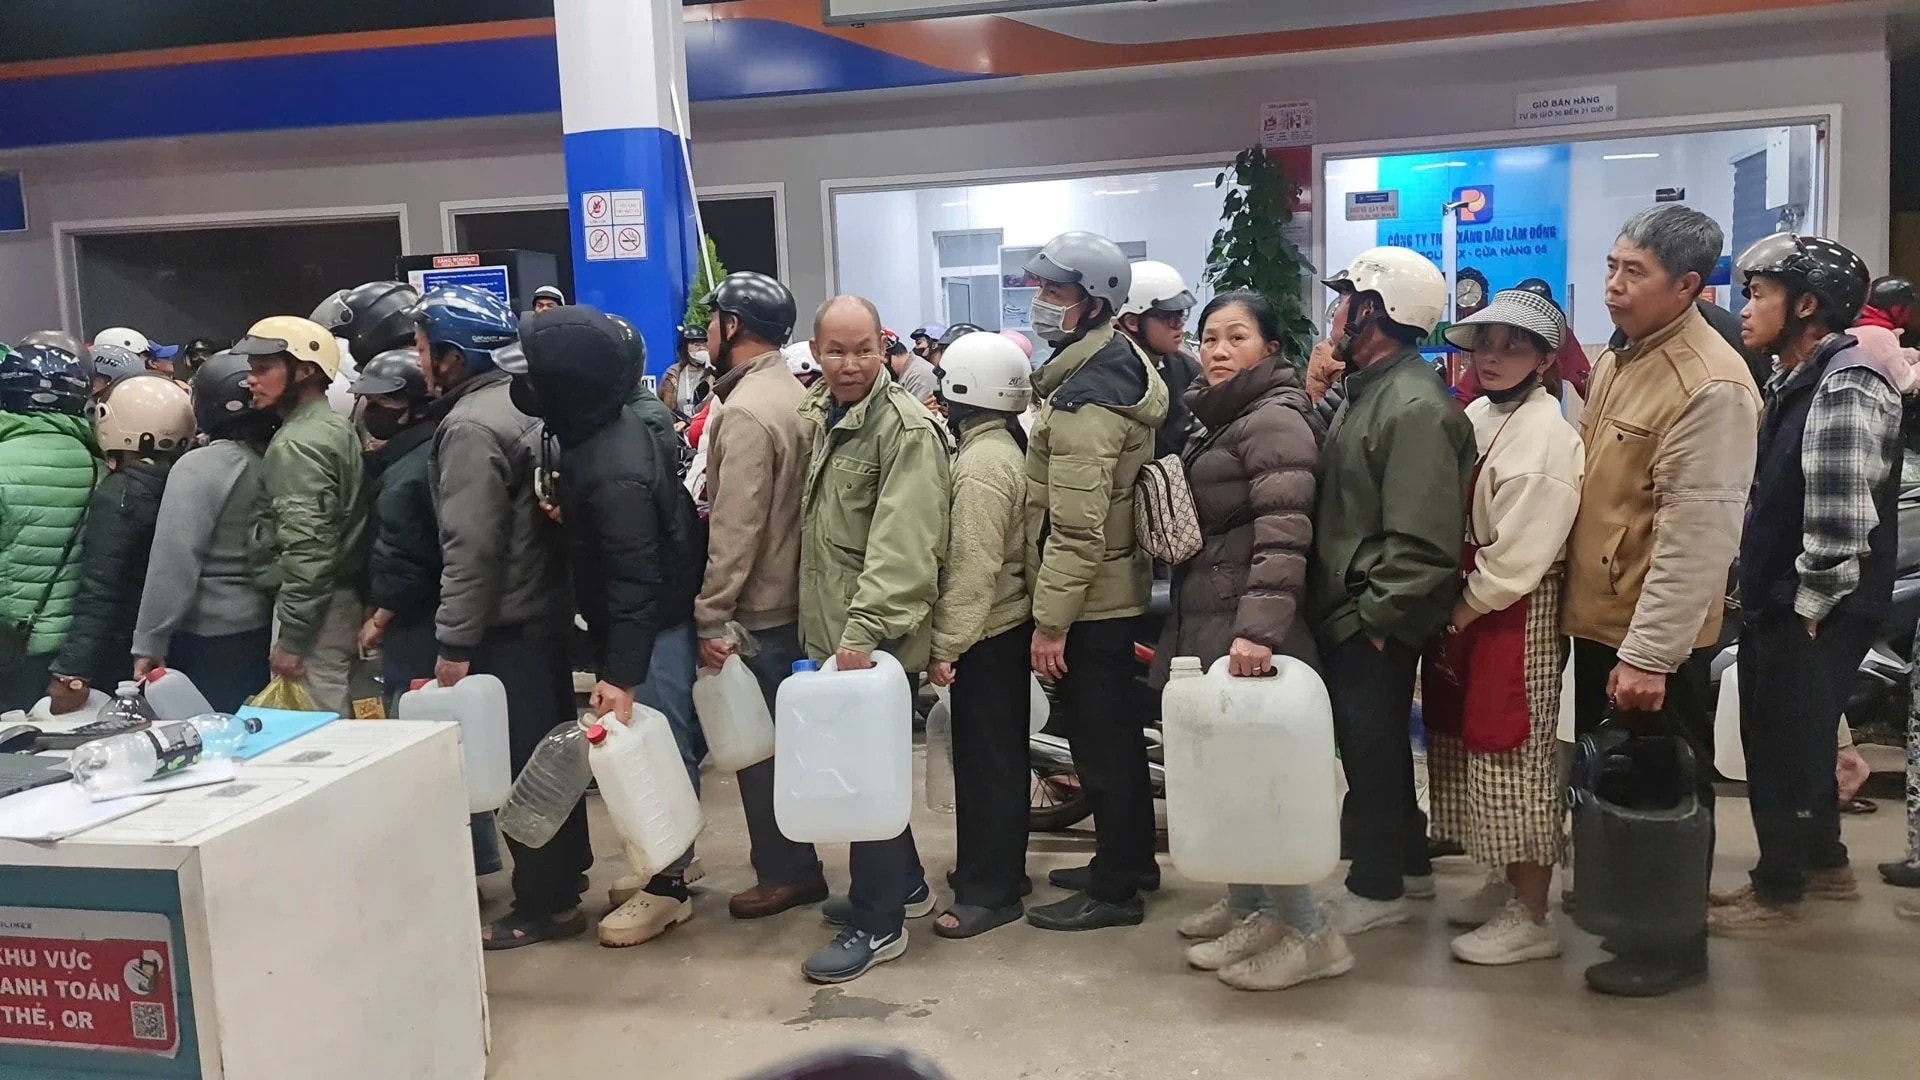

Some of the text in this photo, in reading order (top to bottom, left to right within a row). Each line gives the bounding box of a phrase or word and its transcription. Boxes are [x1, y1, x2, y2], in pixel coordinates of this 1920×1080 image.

[1387, 232, 1413, 247] CÔNG
[1415, 233, 1428, 246] TY
[1501, 244, 1531, 257] HÀNG
[43, 948, 93, 975] VỰC
[54, 977, 121, 1002] TOÁN
